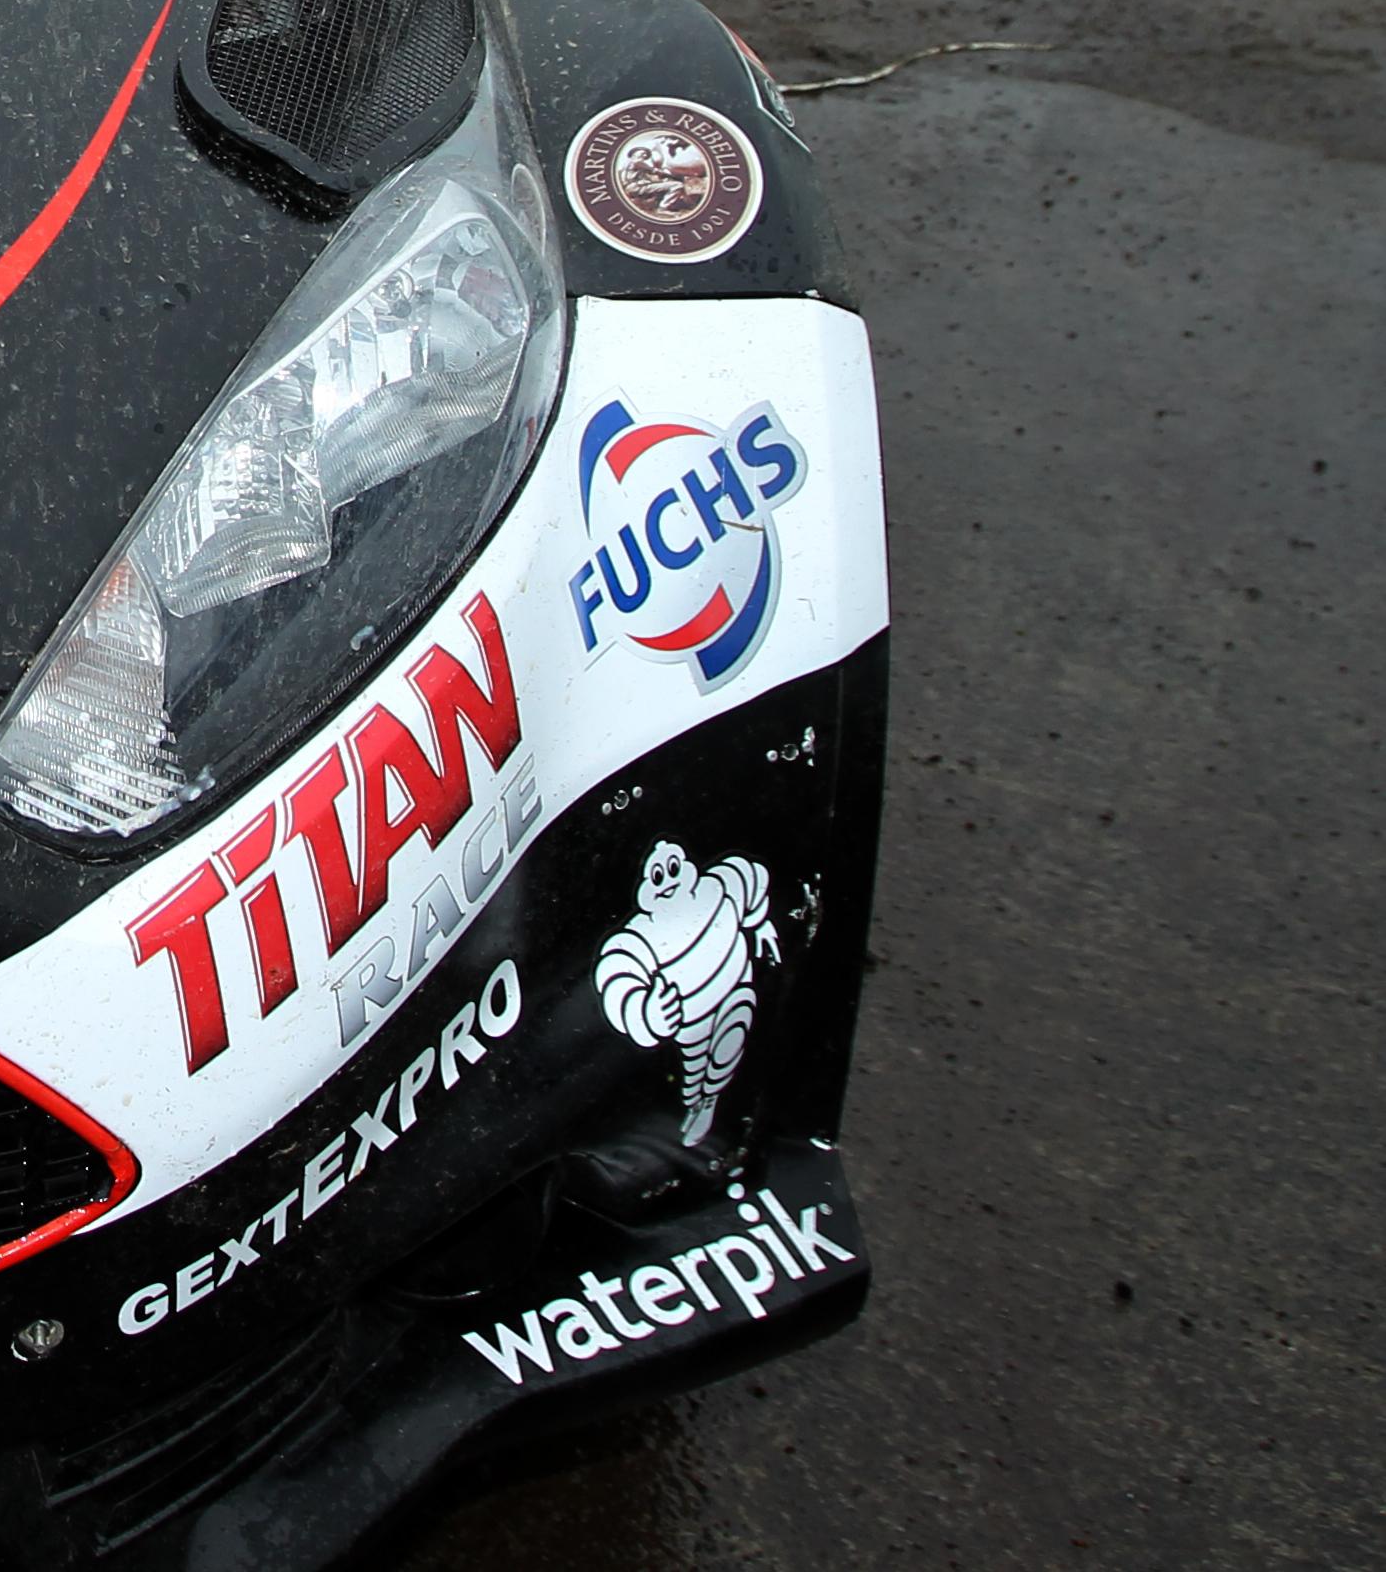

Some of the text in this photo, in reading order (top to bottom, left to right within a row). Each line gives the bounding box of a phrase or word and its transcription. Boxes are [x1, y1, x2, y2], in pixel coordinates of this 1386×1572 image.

[584, 109, 743, 205] MARTINS & REBELLO
[608, 206, 733, 246] DESDE 1901
[567, 414, 797, 654] FUCHS
[330, 751, 543, 1049] RACE
[117, 958, 522, 1335] GEXTEXPRO
[461, 1170, 856, 1385] waterpik
